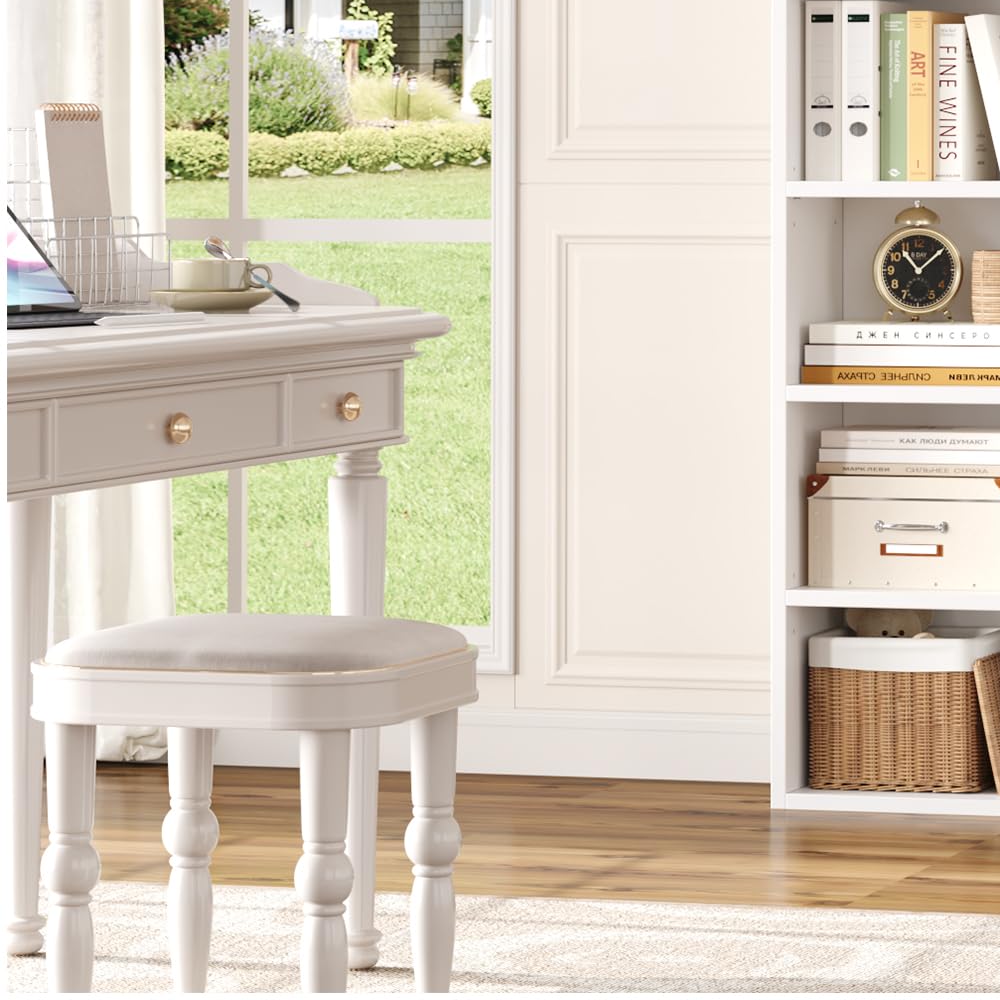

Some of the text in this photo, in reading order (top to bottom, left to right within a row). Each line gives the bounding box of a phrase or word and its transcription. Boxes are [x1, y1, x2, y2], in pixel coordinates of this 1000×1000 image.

[910, 51, 926, 78] ART
[938, 46, 957, 87] FINE
[938, 97, 957, 160] WINES
[914, 239, 924, 248] 12
[890, 252, 901, 262] 10
[887, 265, 895, 275] 9
[891, 279, 899, 289] 8
[938, 281, 945, 289] 4
[901, 289, 908, 299] 7
[928, 290, 936, 299] 5
[856, 331, 990, 340] ДЖЕН СИНСЕРО
